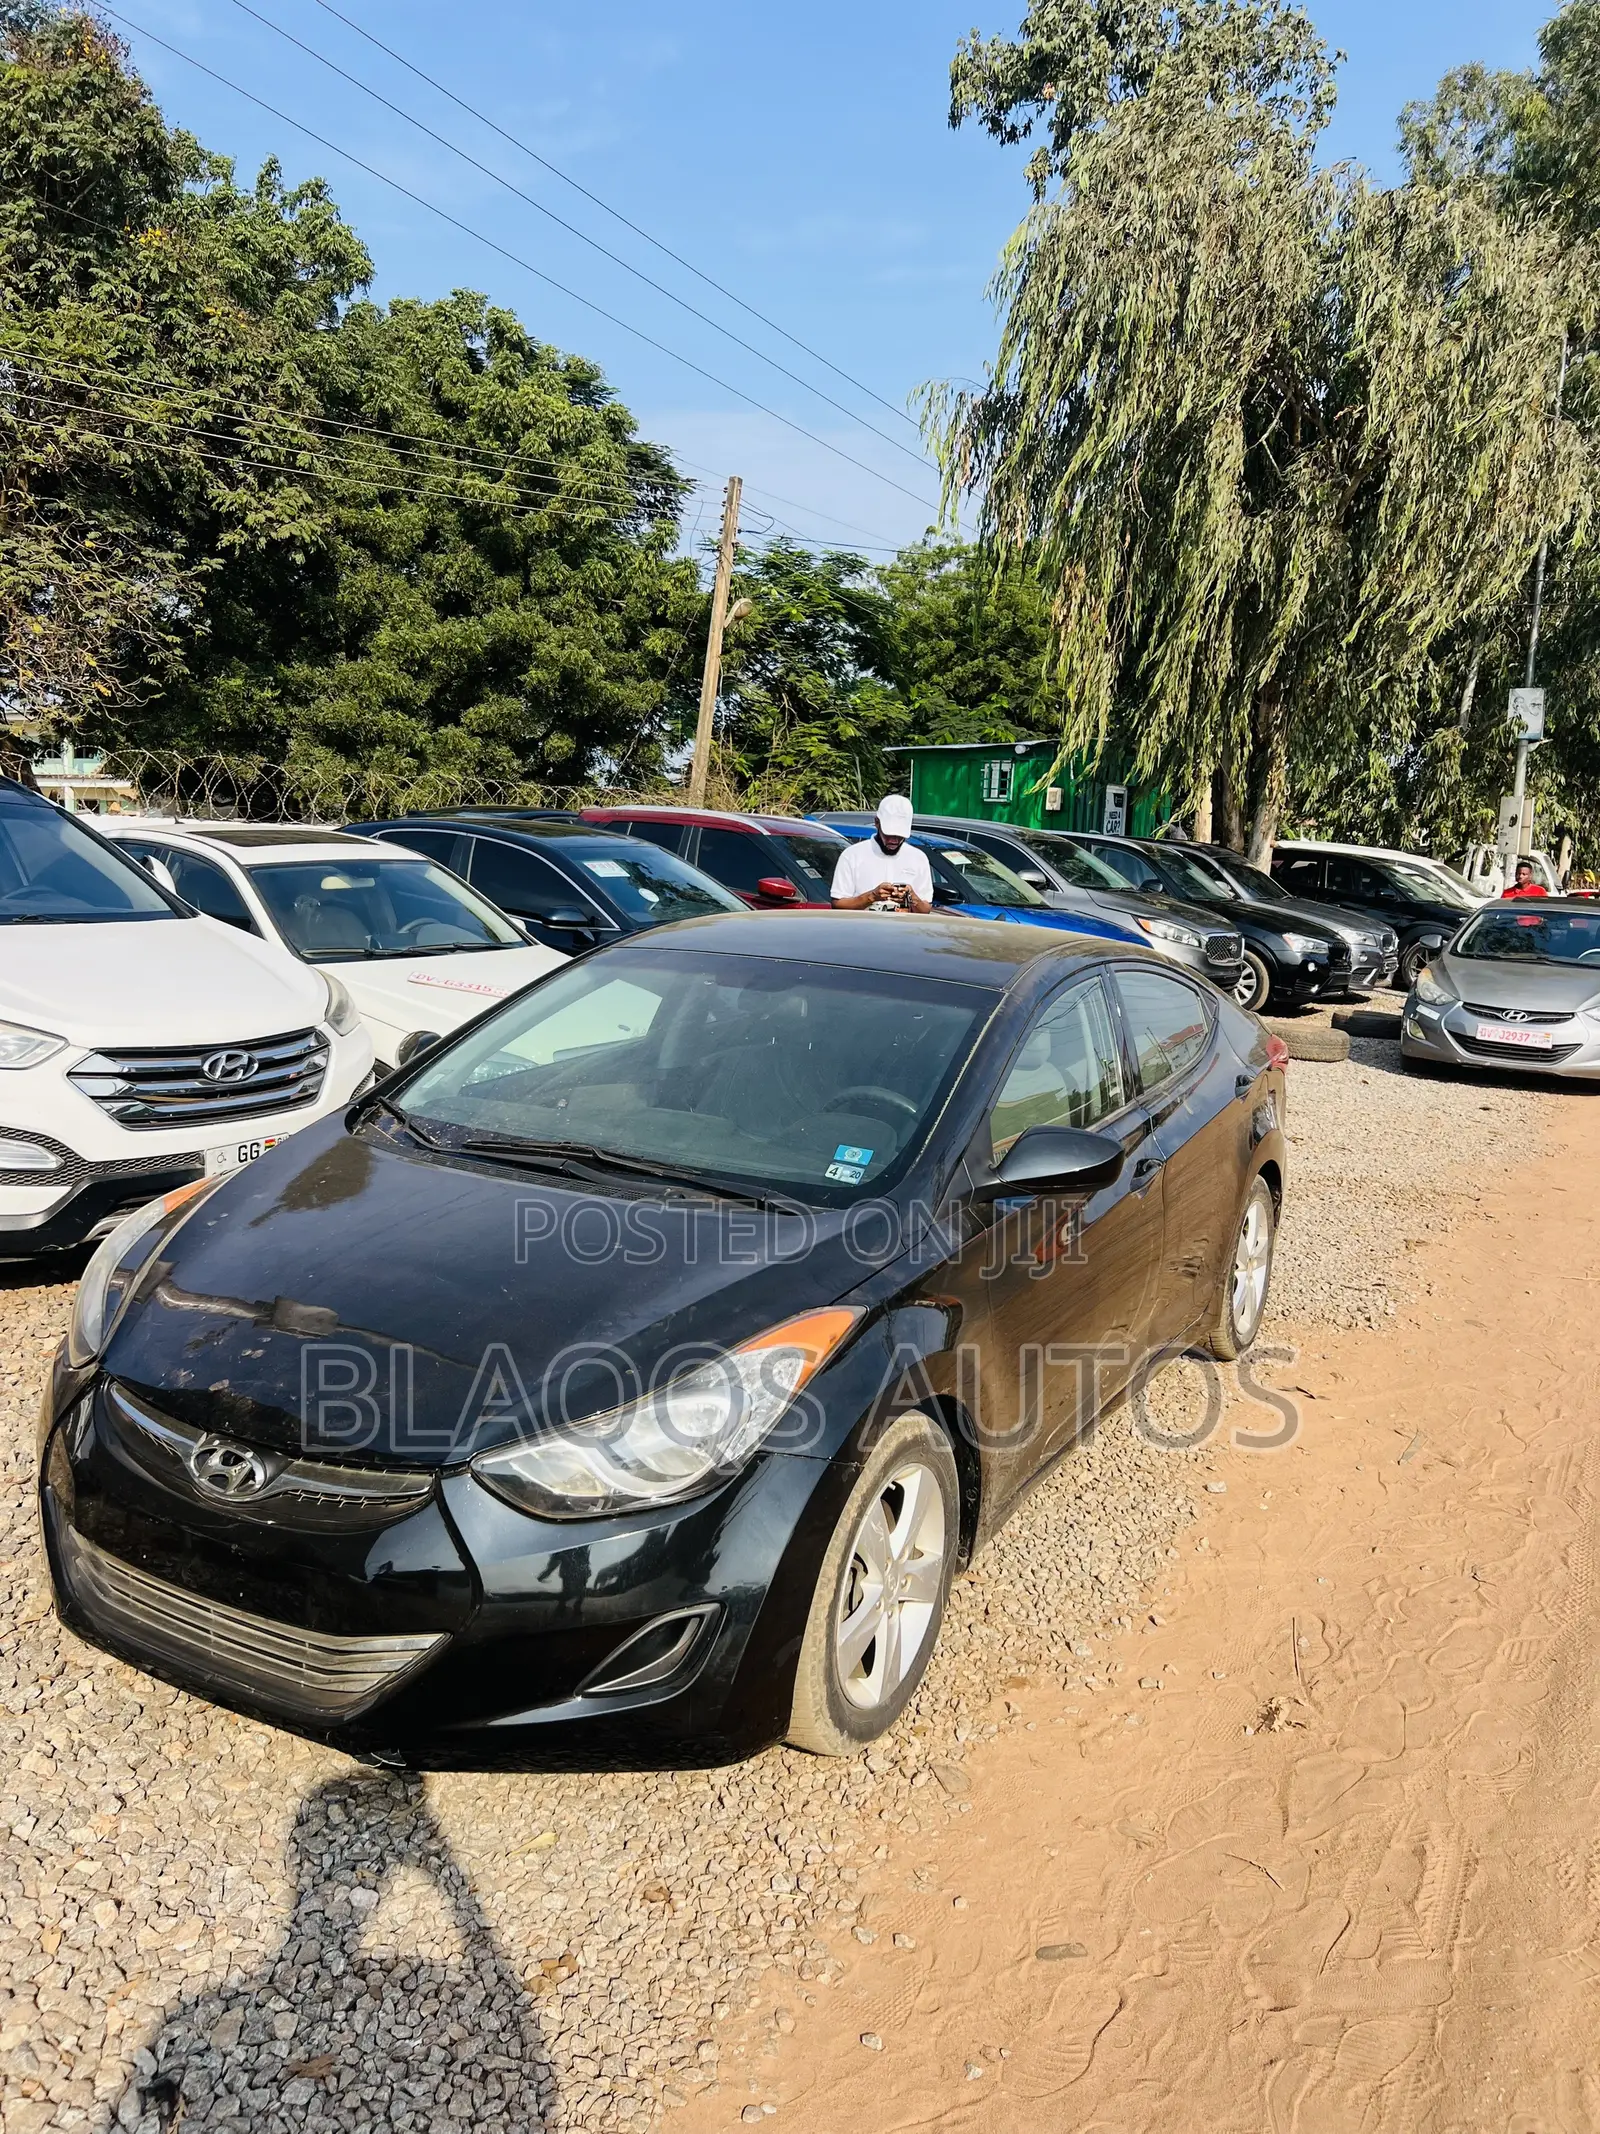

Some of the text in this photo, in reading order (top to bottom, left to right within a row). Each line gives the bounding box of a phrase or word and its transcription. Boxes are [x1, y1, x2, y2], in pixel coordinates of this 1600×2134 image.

[1499, 1029, 1531, 1043] J2937
[238, 1142, 261, 1163] GG
[829, 1167, 862, 1179] 4 20
